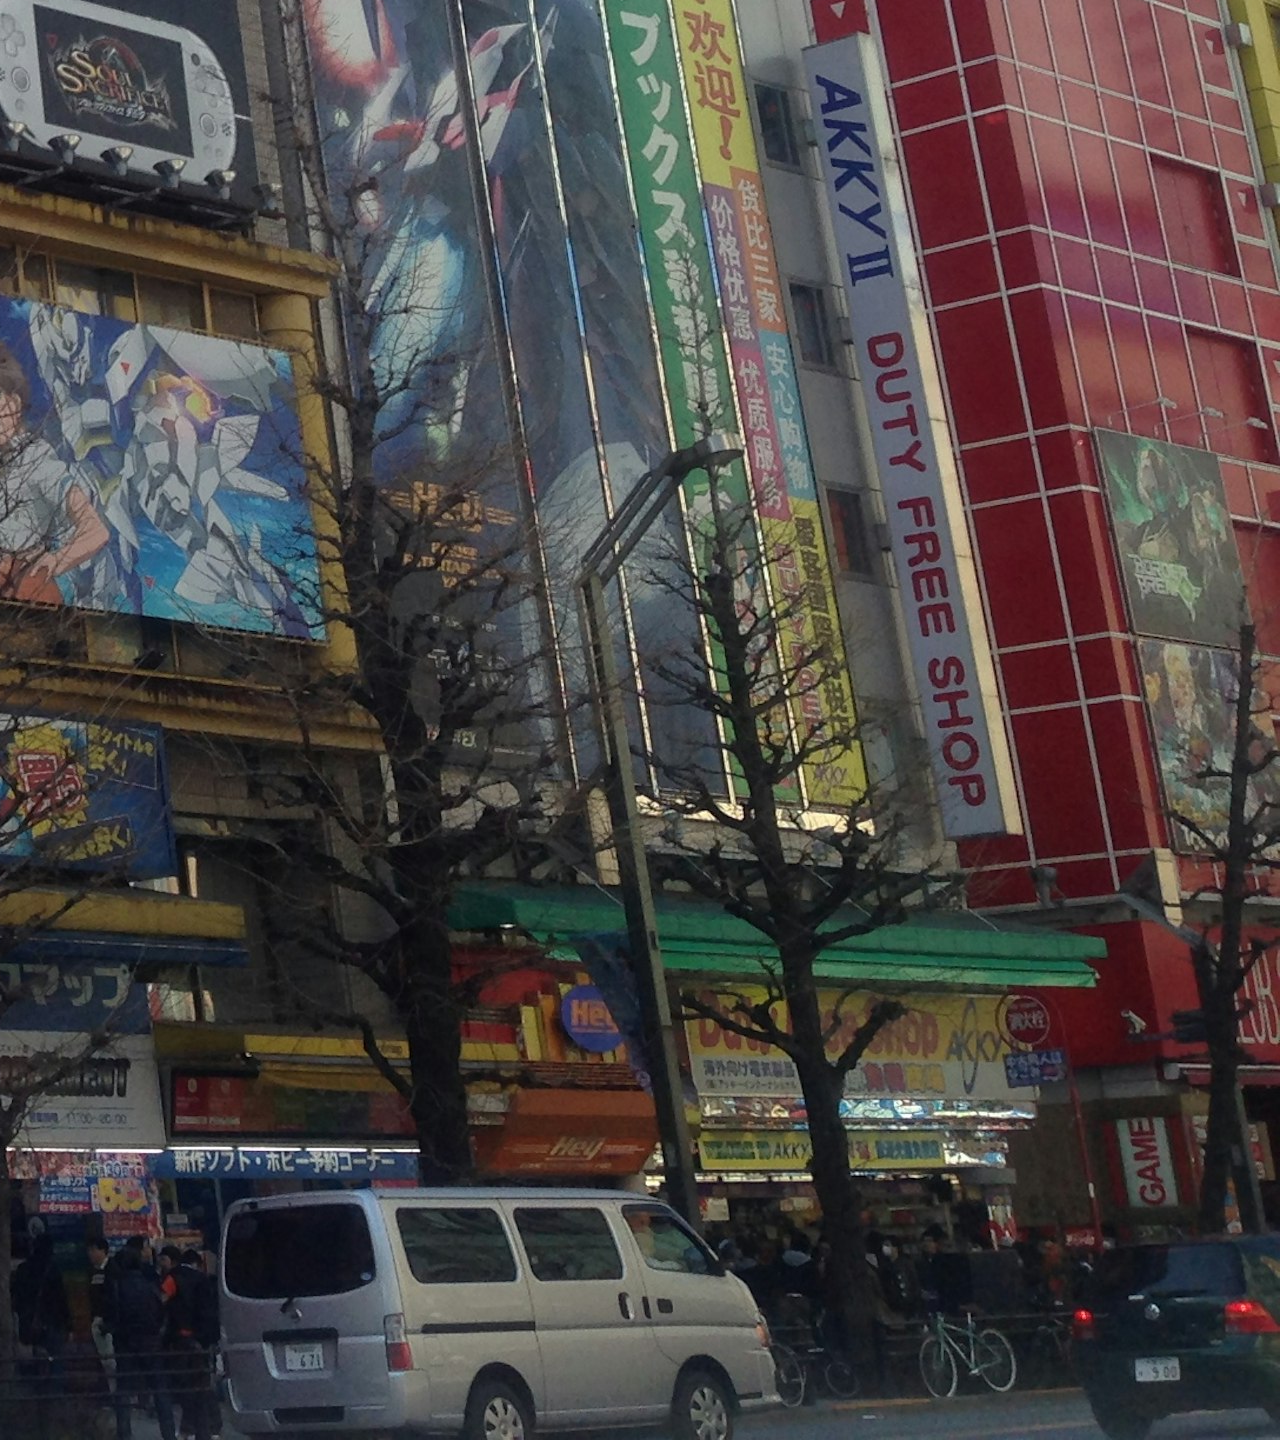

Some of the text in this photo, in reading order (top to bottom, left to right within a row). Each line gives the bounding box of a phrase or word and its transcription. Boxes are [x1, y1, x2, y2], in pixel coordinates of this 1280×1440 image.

[867, 333, 988, 809] DUTY FREE SHOP
[1127, 1116, 1168, 1207] GAME
